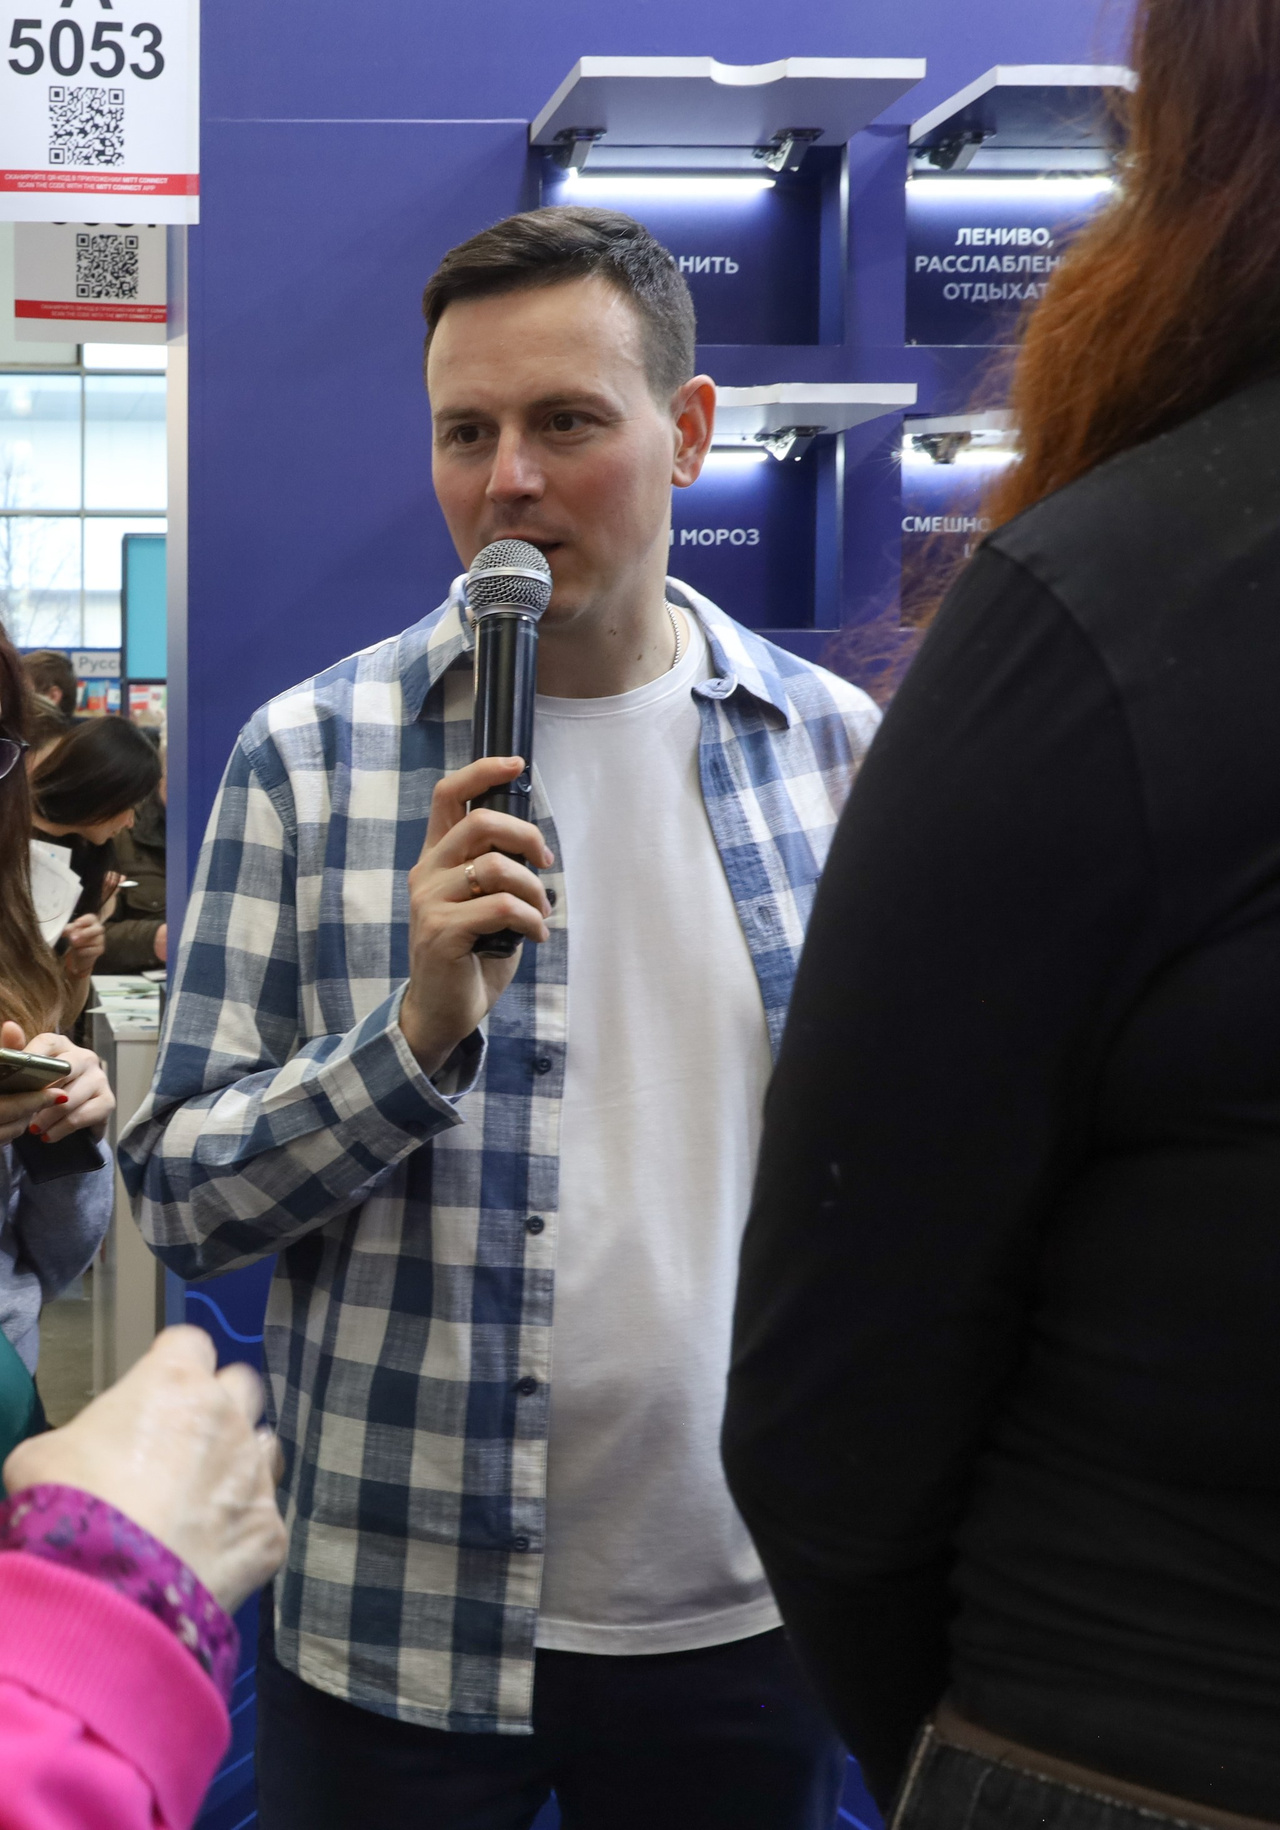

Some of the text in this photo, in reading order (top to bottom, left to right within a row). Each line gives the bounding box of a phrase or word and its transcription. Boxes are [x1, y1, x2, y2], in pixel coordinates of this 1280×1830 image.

[8, 18, 165, 80] 5053
[954, 227, 1055, 249] ЛЕНИВО,
[669, 255, 739, 274] НИТЬ
[914, 255, 1067, 273] РАССЛАБЛЕН
[680, 528, 760, 546] МОРОЗ
